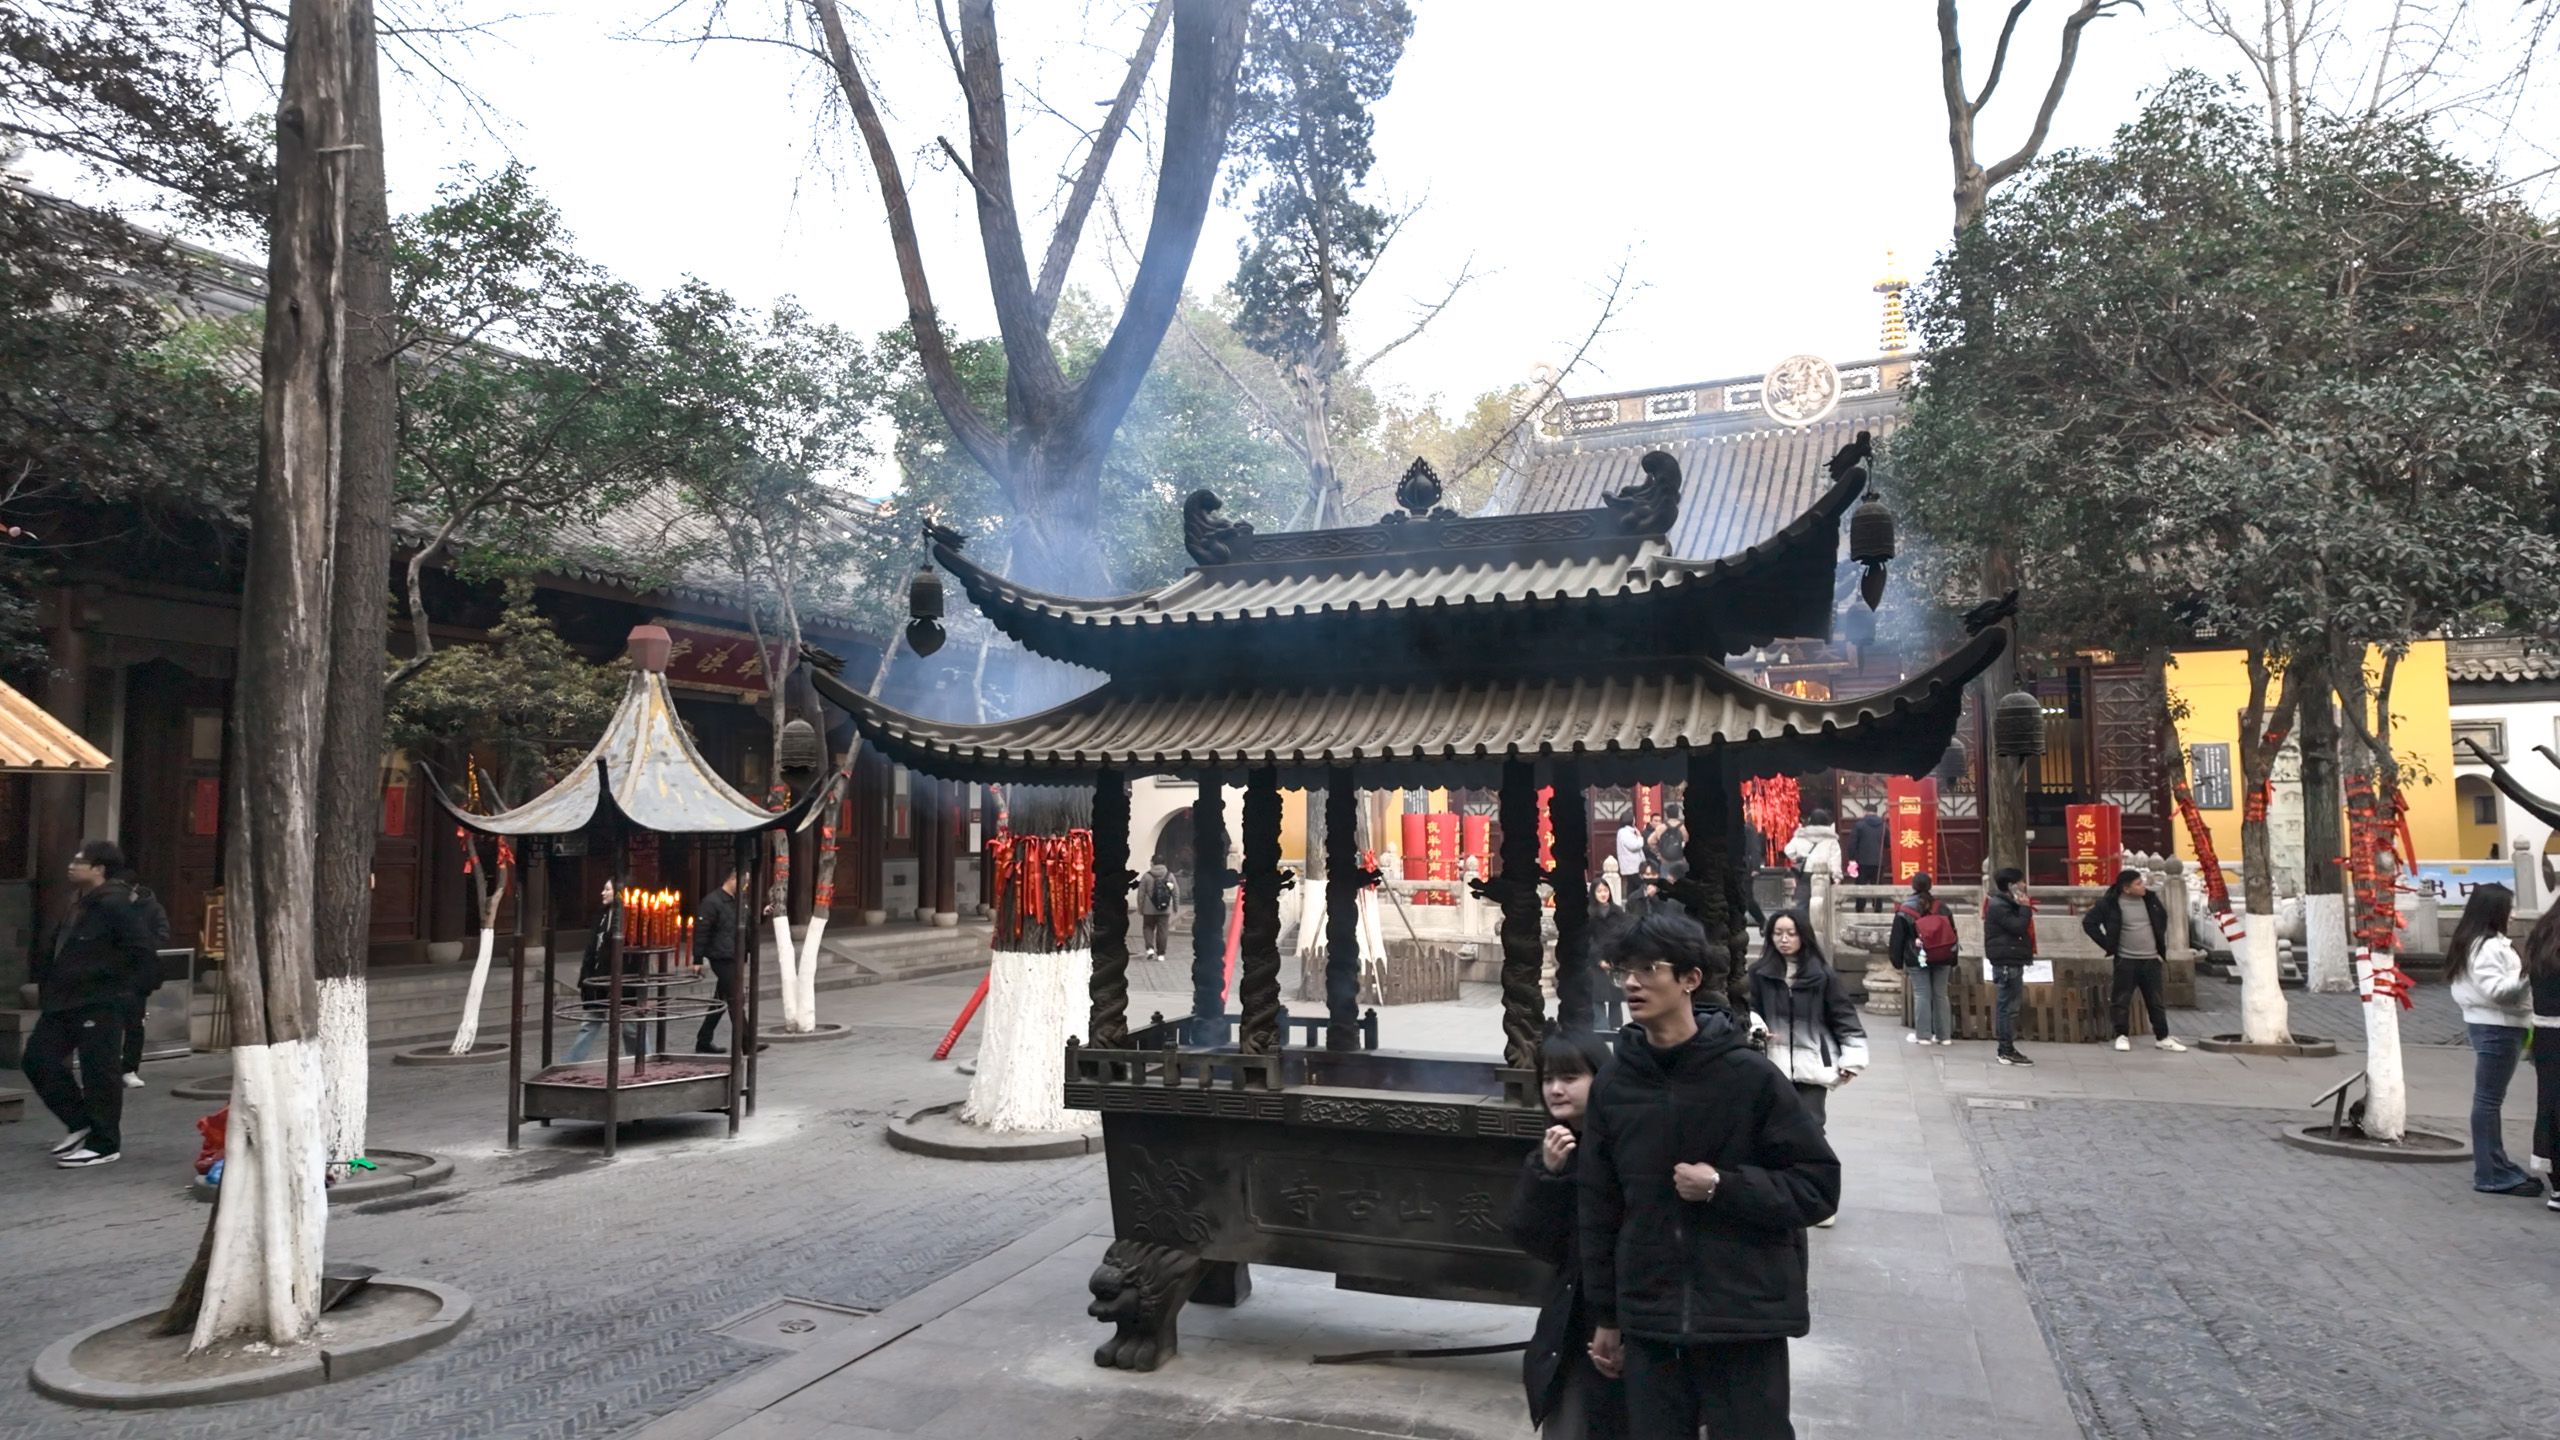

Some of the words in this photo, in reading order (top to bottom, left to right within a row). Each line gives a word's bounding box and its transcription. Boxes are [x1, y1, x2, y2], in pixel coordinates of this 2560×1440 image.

[1899, 796, 1924, 880] 国泰民
[1280, 1168, 1503, 1232] 寒山古寺
